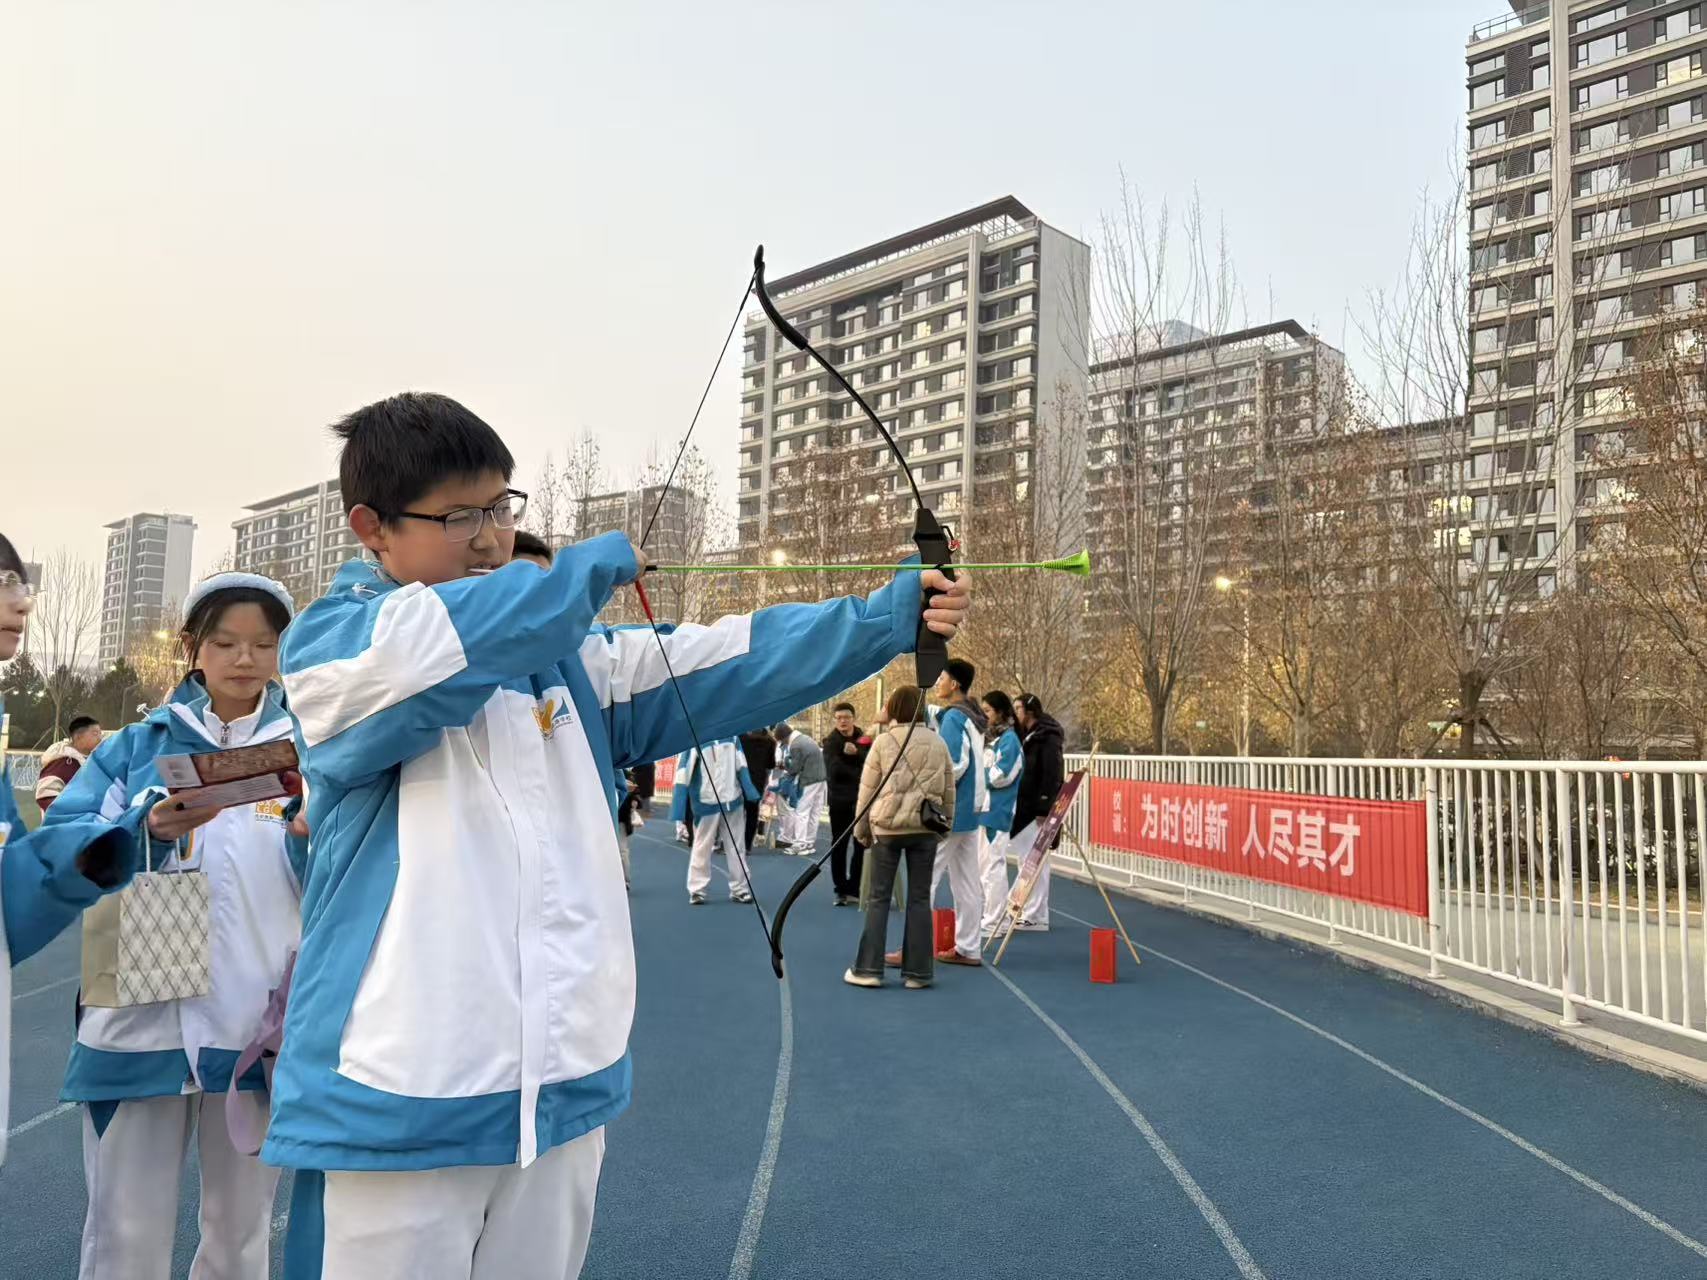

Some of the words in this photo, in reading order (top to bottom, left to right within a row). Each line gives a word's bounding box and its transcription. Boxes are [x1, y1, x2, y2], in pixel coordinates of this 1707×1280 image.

[1140, 792, 1228, 853] 为时创新
[1241, 803, 1361, 876] 人尽其才
